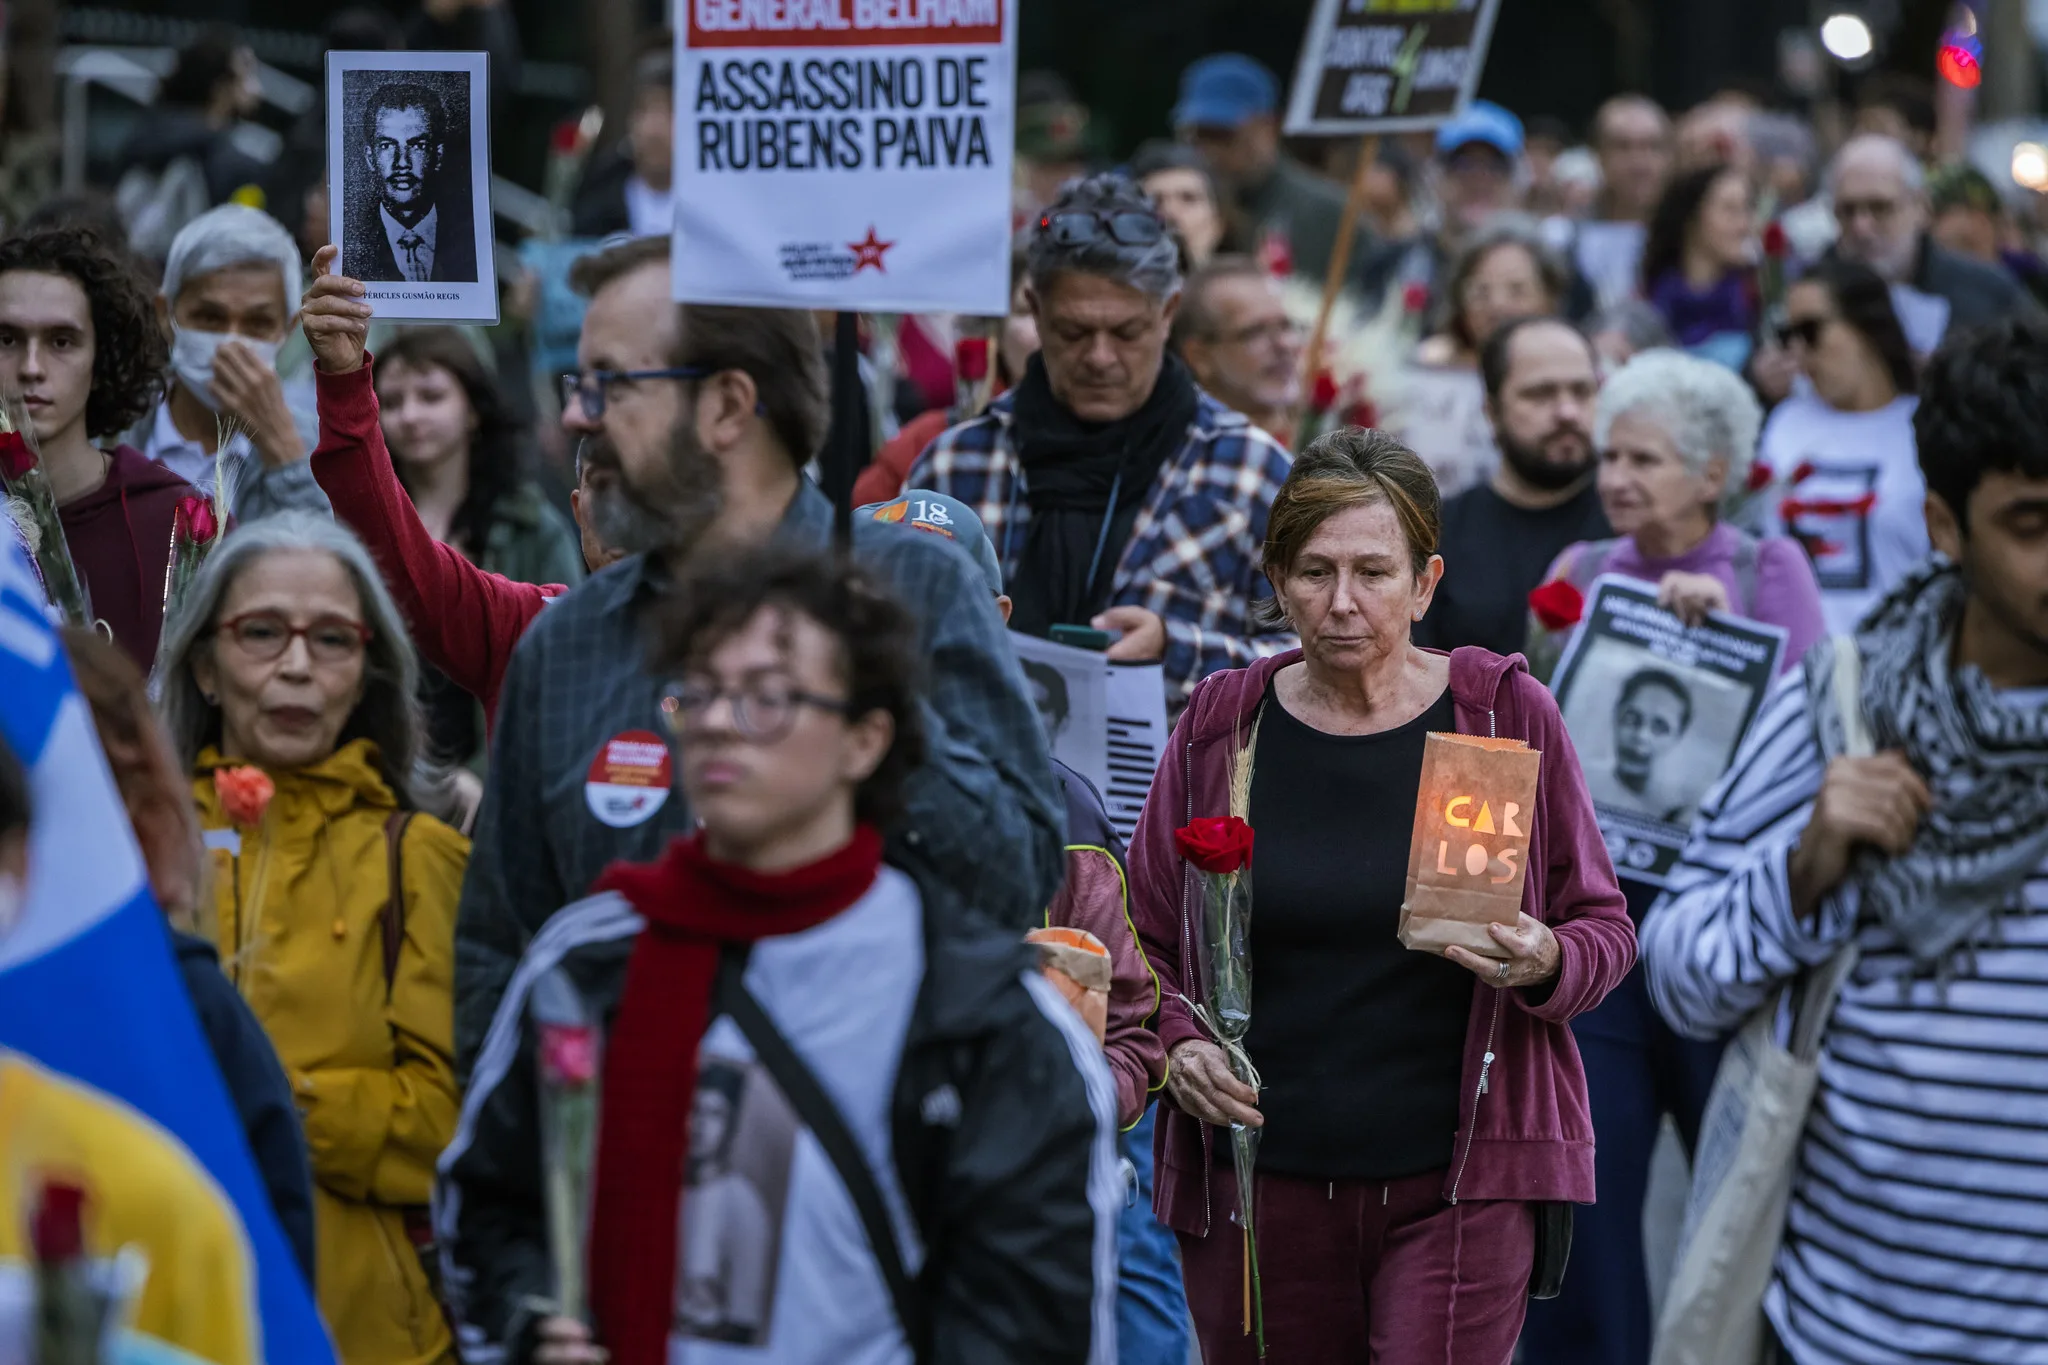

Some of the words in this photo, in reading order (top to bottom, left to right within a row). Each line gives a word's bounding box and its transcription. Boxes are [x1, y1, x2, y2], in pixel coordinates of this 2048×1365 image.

[695, 0, 849, 31] GENERAL
[696, 58, 924, 111] ASSASSINO
[936, 57, 990, 107] DE
[699, 119, 863, 170] RUBENS
[874, 115, 991, 169] PAIVA
[364, 290, 401, 300] PÉRICLES
[402, 291, 435, 300] GUSMÃO
[436, 292, 460, 301] REGIS
[1445, 796, 1523, 837] CAR
[1437, 840, 1518, 885] LOS
